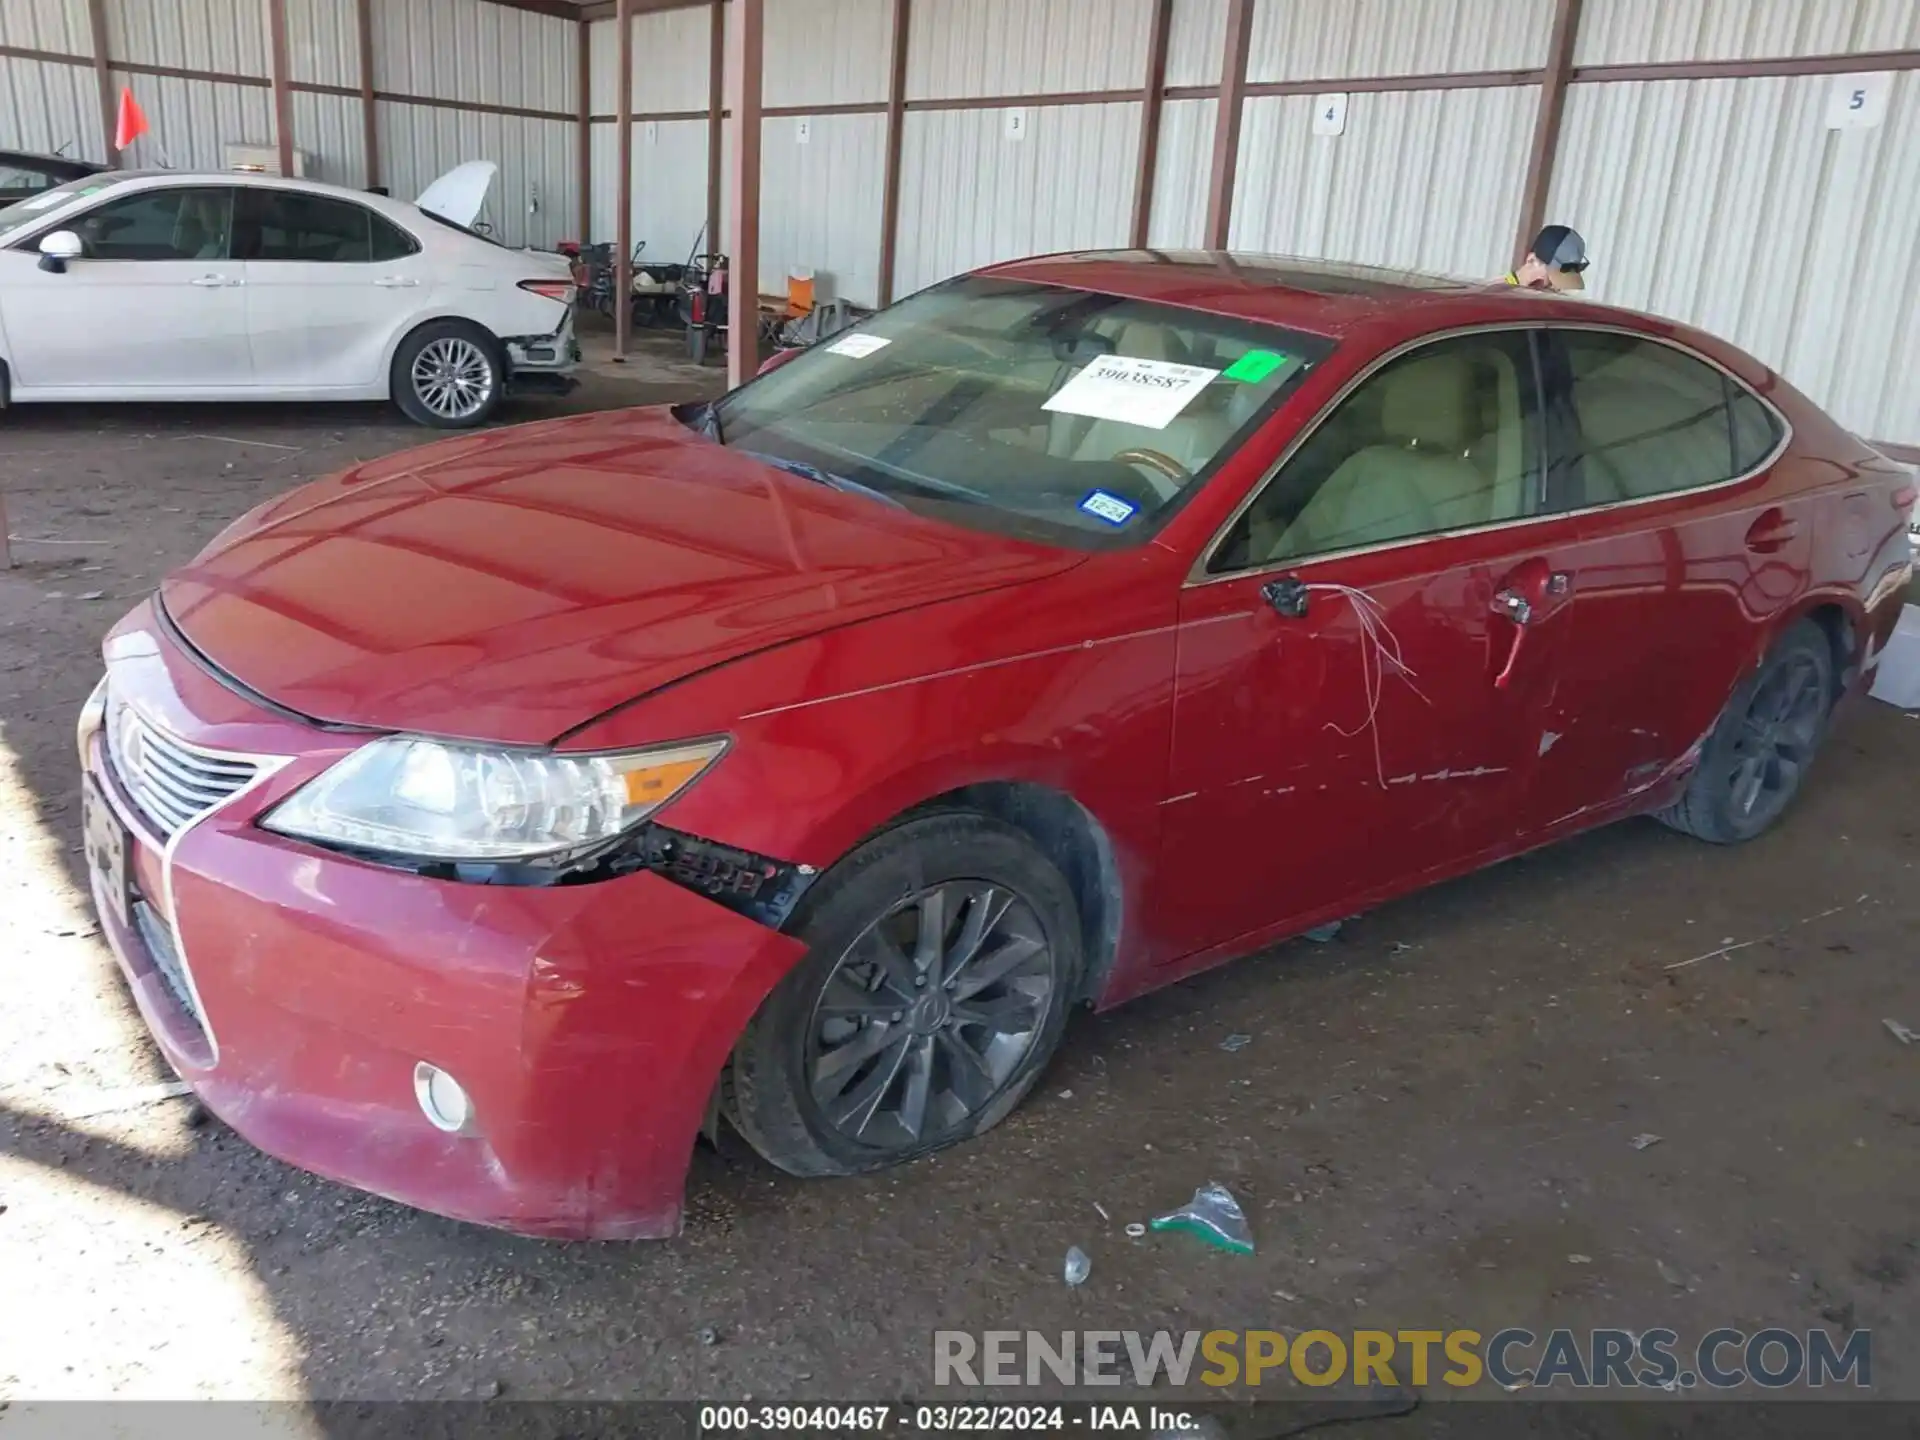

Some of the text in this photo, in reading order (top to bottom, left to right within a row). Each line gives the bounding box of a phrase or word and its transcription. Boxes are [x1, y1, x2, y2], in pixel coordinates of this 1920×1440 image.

[1849, 89, 1866, 110] 5
[1325, 105, 1334, 121] 4
[1012, 116, 1020, 130] 3
[1091, 367, 1192, 391] 39038587
